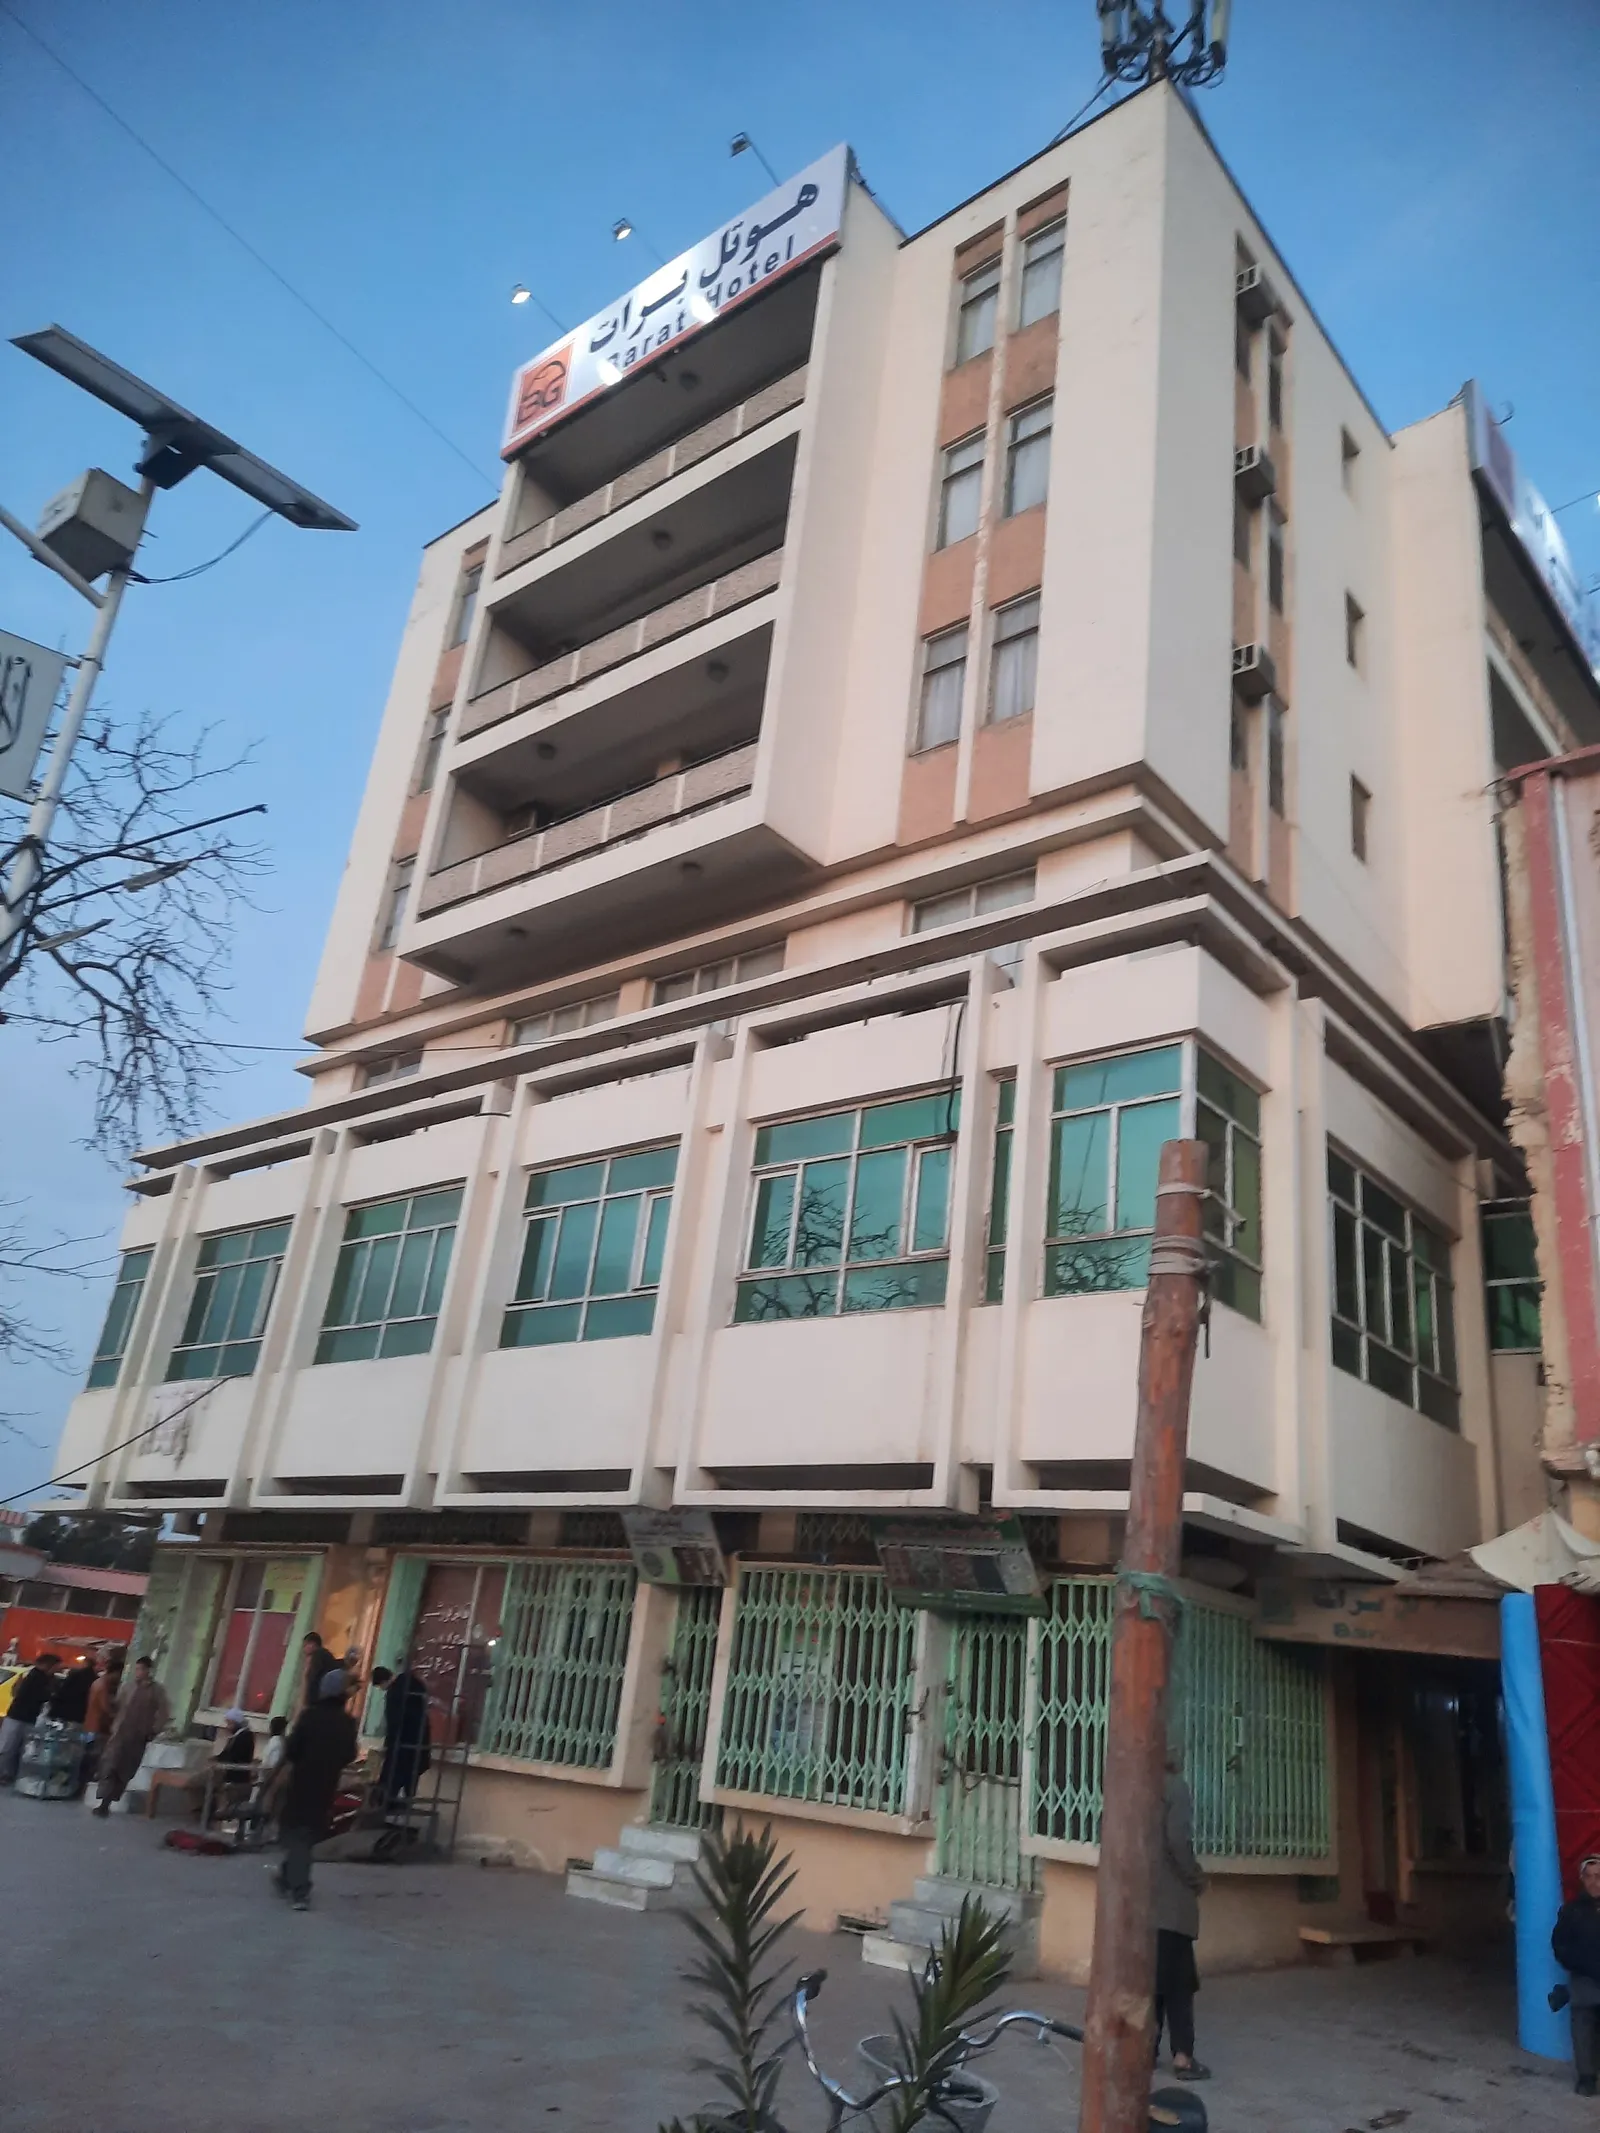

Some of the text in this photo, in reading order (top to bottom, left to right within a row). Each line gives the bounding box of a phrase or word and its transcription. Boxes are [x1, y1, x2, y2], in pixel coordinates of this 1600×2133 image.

[590, 183, 818, 353] هوتل برات
[706, 233, 795, 309] Hotel
